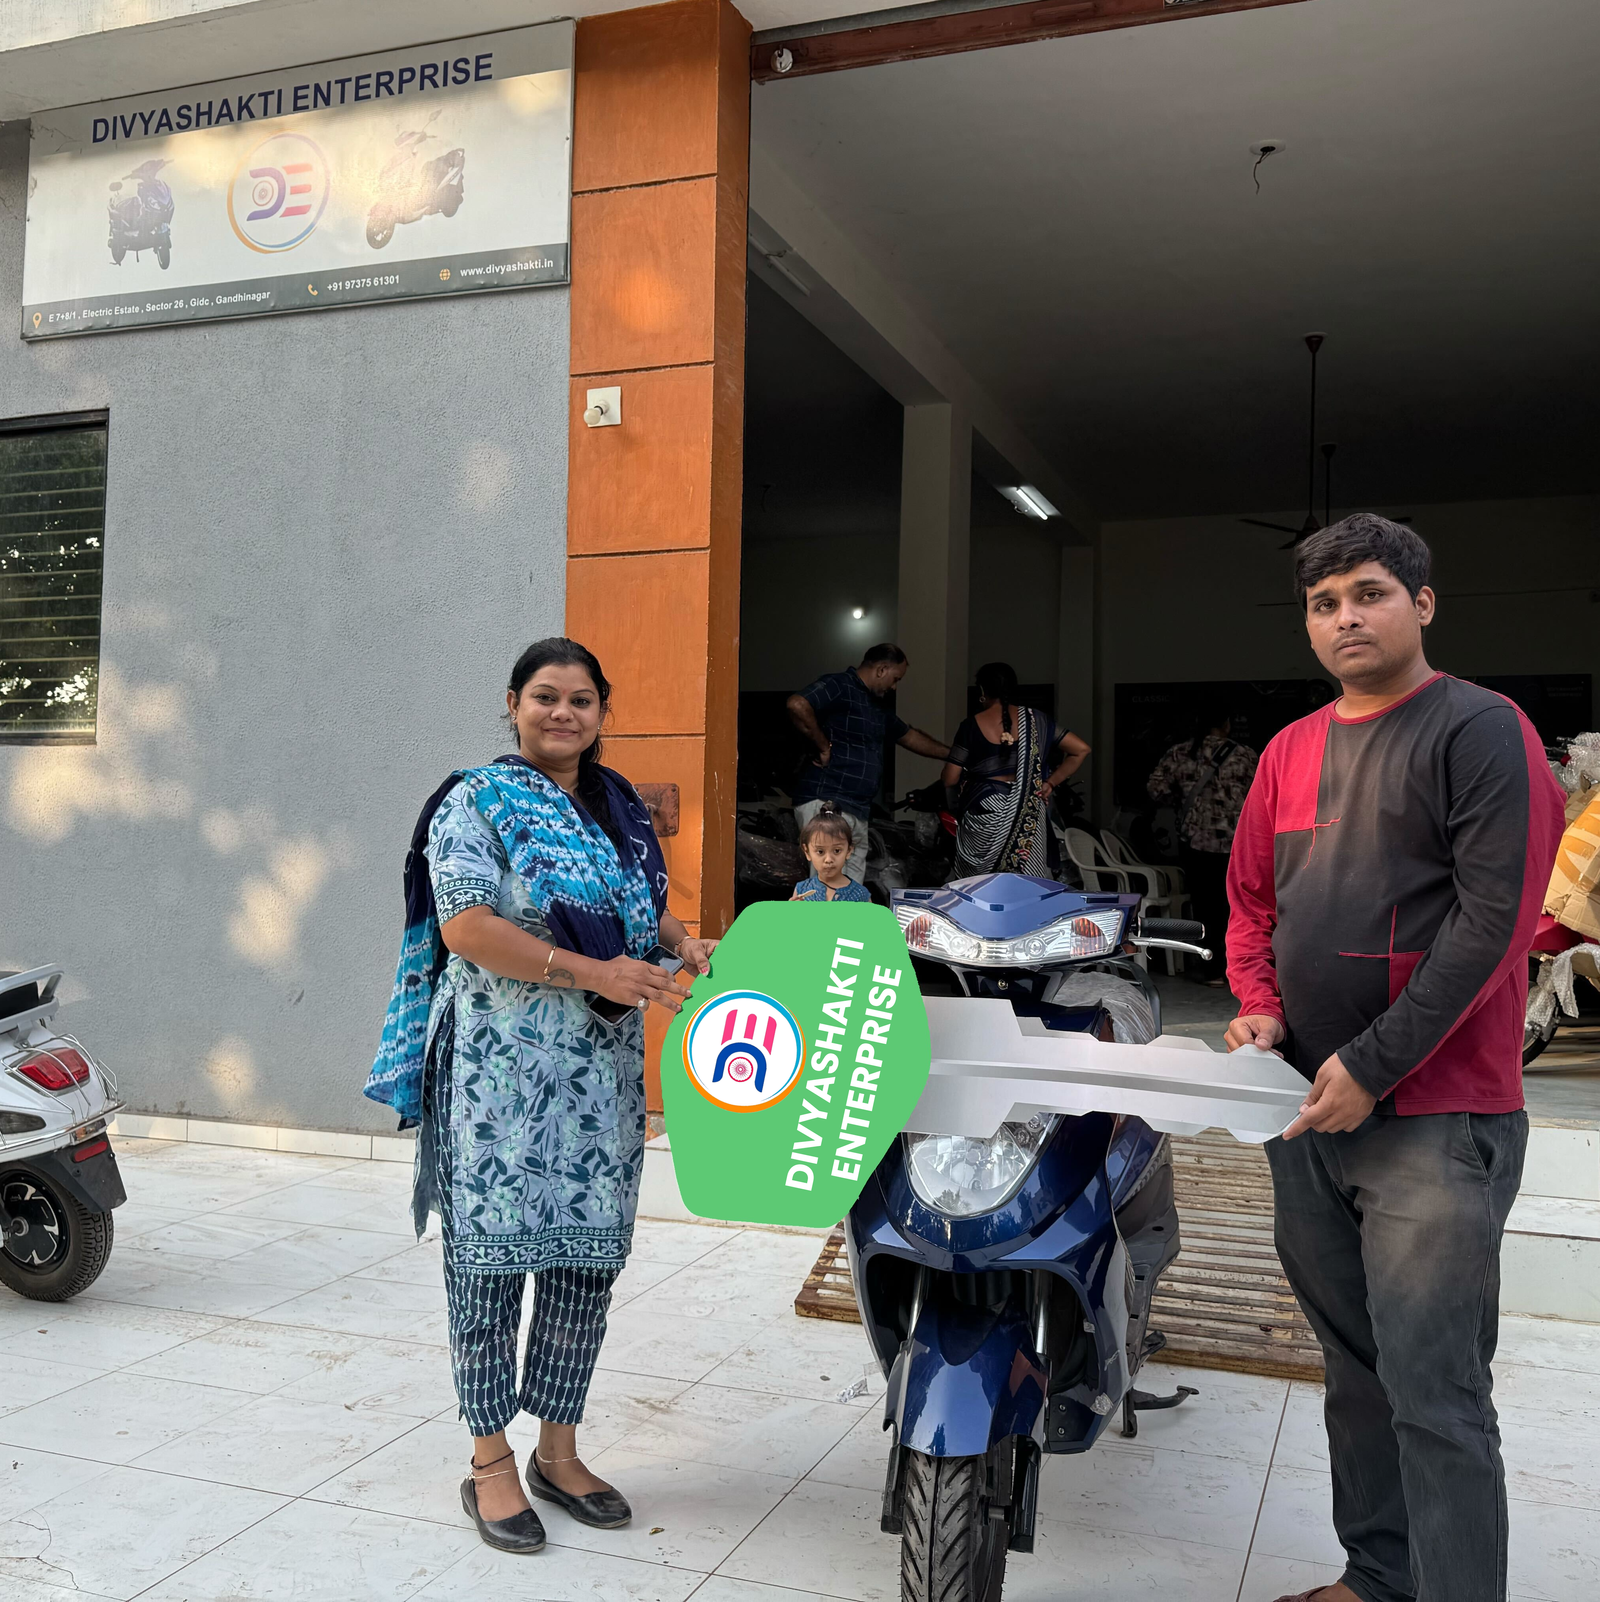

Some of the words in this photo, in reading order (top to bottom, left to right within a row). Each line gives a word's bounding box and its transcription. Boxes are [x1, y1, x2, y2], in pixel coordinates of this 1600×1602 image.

[91, 87, 283, 144] DIVYASHAKTI
[292, 52, 494, 112] ENTERPRISE
[327, 282, 343, 291] +91
[345, 277, 372, 290] 97375
[373, 274, 400, 287] 61301
[460, 258, 554, 277] www.divyashakti.in
[48, 314, 55, 323] E
[56, 311, 76, 322] 7+8/1
[82, 308, 113, 318] Electric
[114, 305, 140, 315] Estate
[145, 301, 173, 312] Sector
[174, 299, 184, 309] 26
[215, 291, 271, 304] Gandhinagar
[1131, 694, 1171, 703] CLASSIC
[785, 937, 864, 1191] DIVYASHAKTI
[831, 965, 902, 1181] ENTERPRISE
